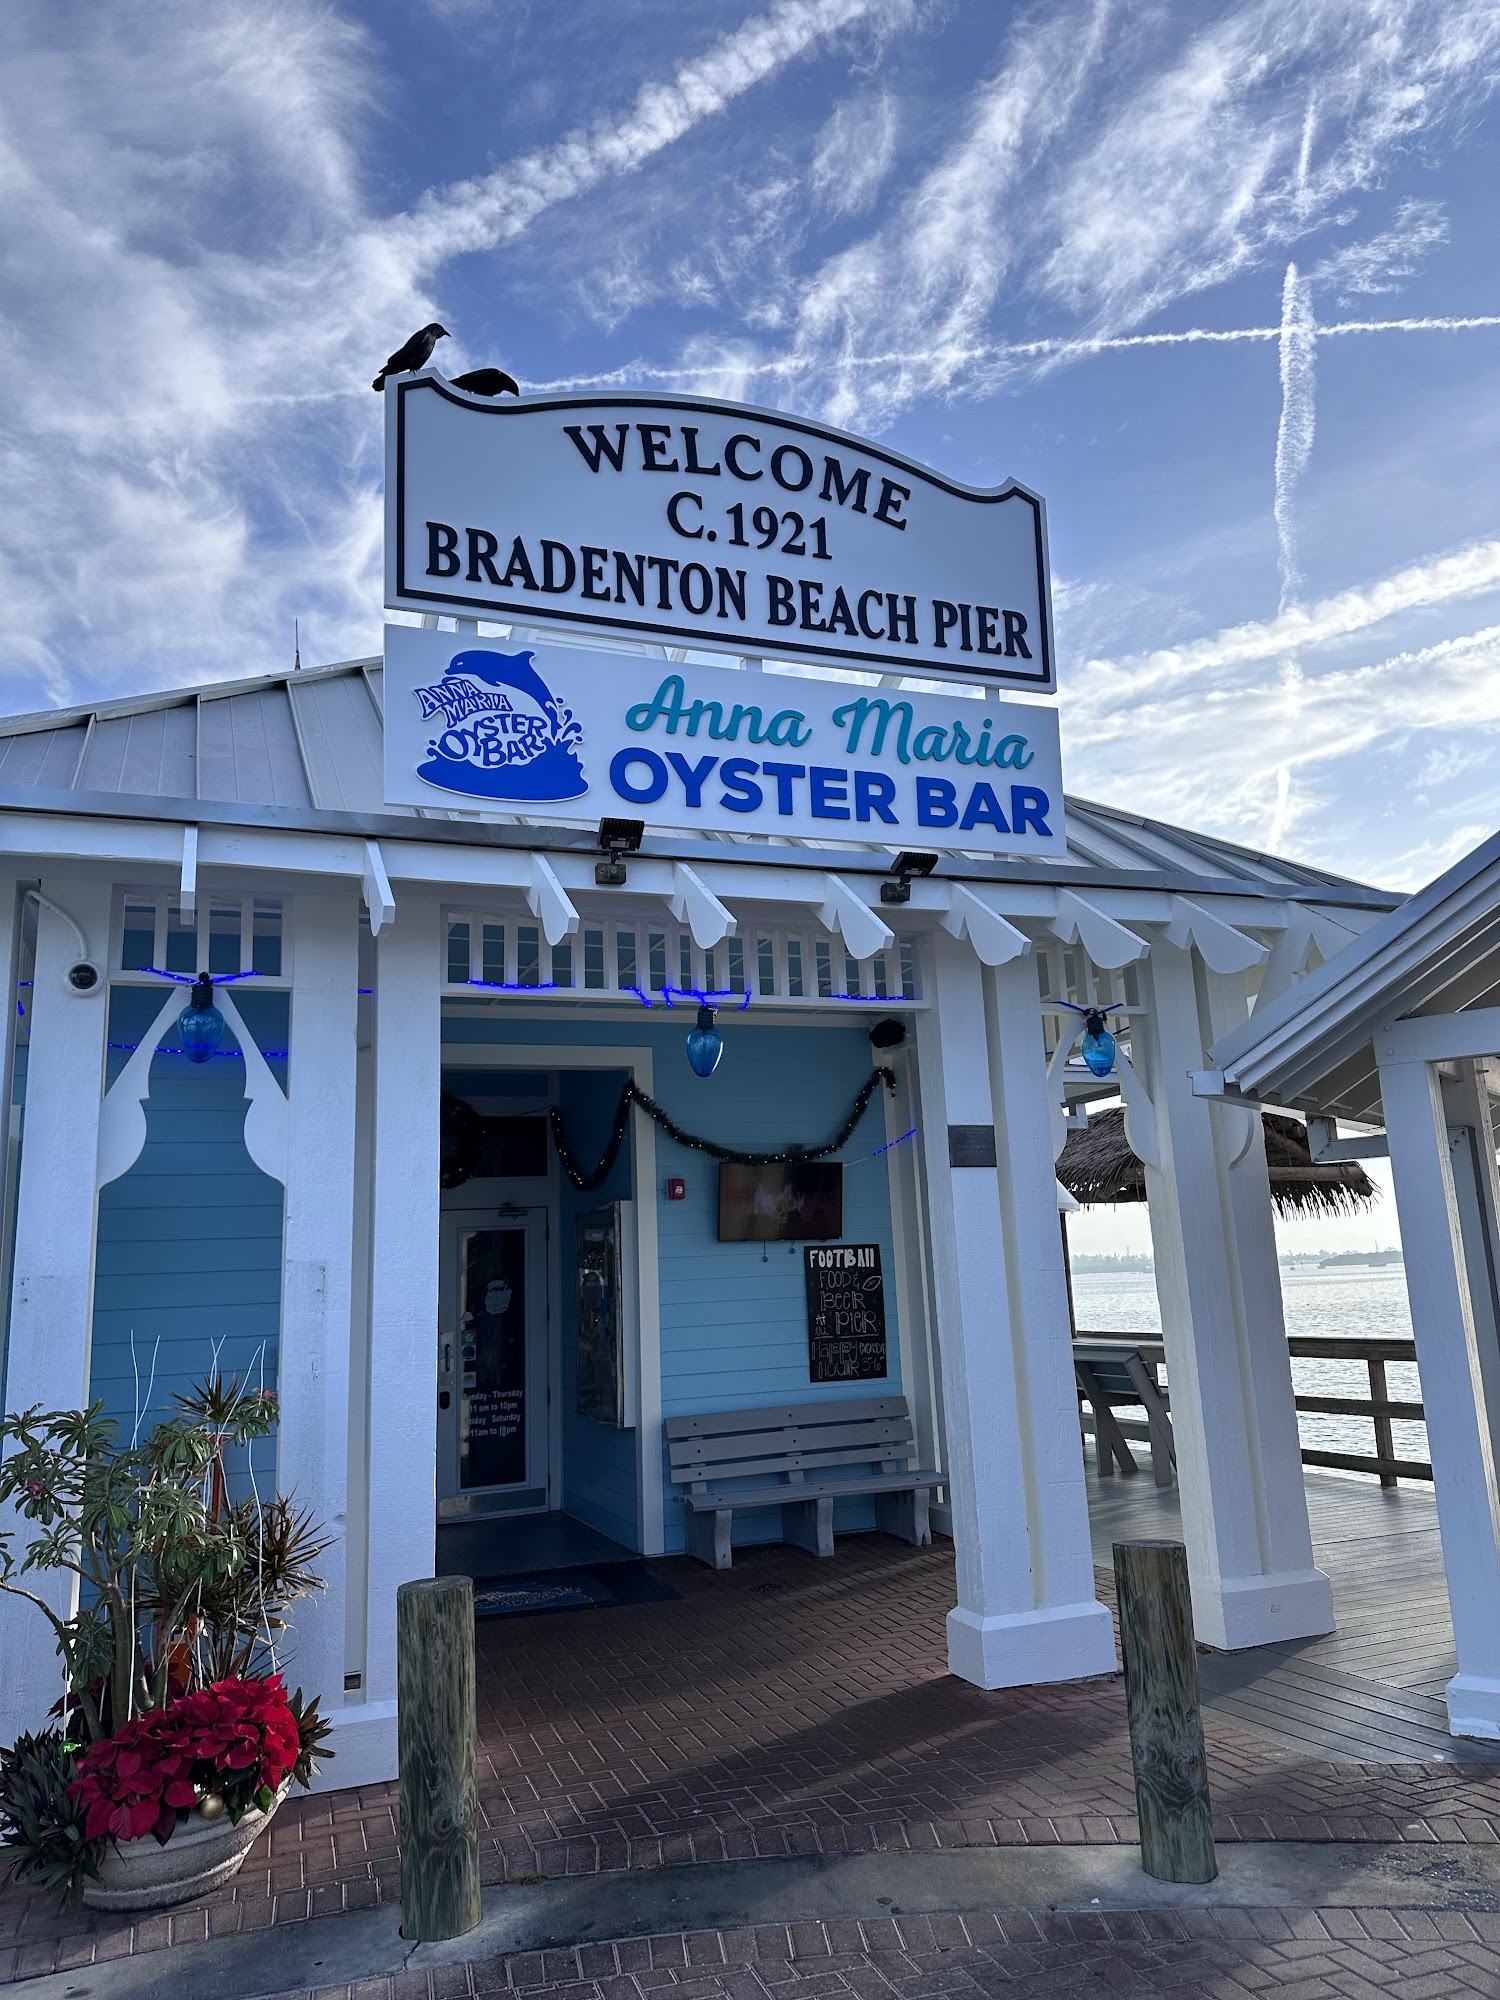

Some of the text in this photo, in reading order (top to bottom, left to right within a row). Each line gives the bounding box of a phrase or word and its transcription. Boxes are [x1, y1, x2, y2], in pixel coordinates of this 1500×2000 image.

[563, 423, 911, 531] WELCOME
[667, 491, 833, 561] C.1921
[425, 521, 1033, 660] BRADENTON BEACH PIER
[417, 679, 482, 718] ANNA
[443, 693, 514, 728] MARIA
[437, 713, 548, 760] OYSTER
[625, 674, 1035, 770] Anna Maria
[480, 733, 546, 767] BAR
[609, 747, 1054, 837] OYSTER BAR
[463, 1392, 488, 1402] Sunday
[493, 1389, 524, 1399] Thursday
[499, 1401, 518, 1411] 10pm
[466, 1413, 522, 1426] riday Saturday
[489, 1427, 497, 1435] to
